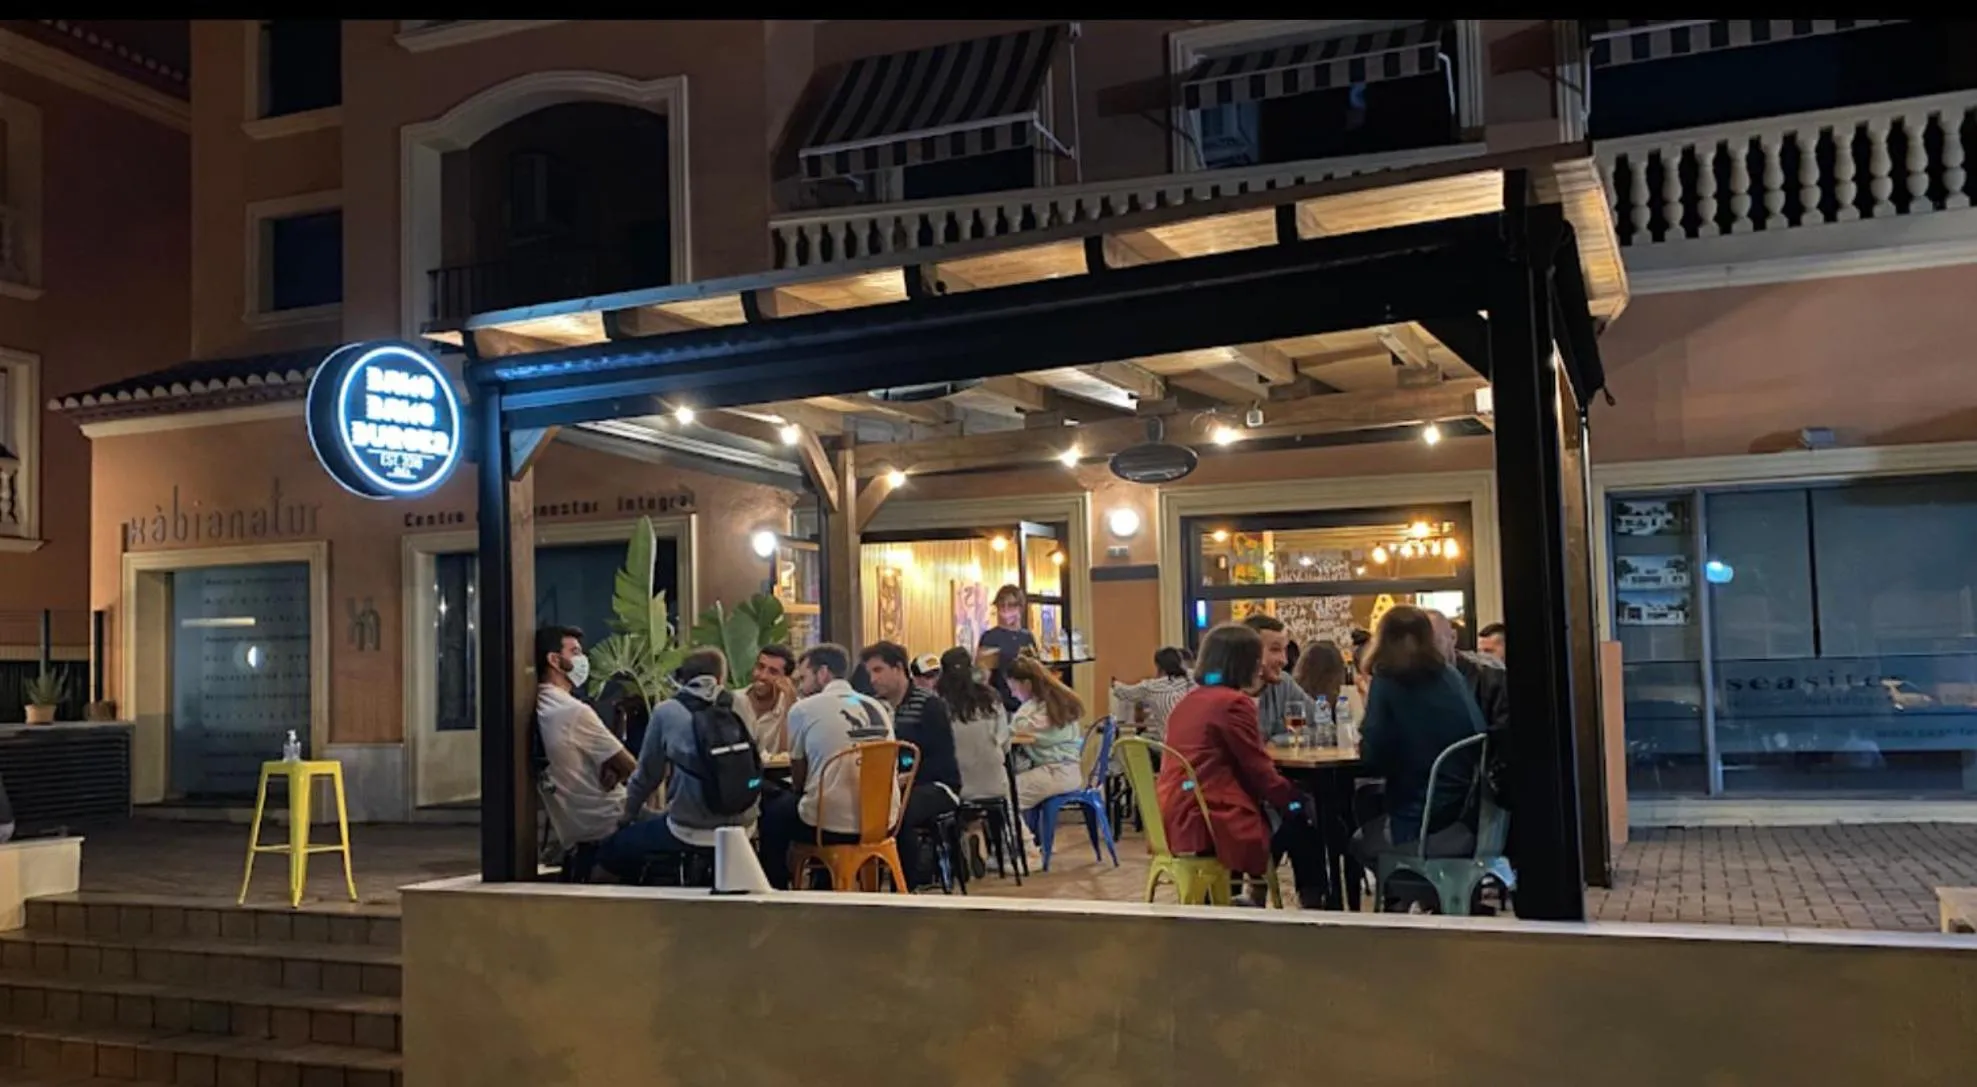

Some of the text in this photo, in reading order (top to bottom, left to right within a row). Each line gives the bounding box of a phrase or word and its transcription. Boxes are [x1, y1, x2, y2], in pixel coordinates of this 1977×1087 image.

[351, 420, 449, 456] BURGER
[131, 477, 323, 545] xàbianatur
[404, 512, 464, 527] Centro
